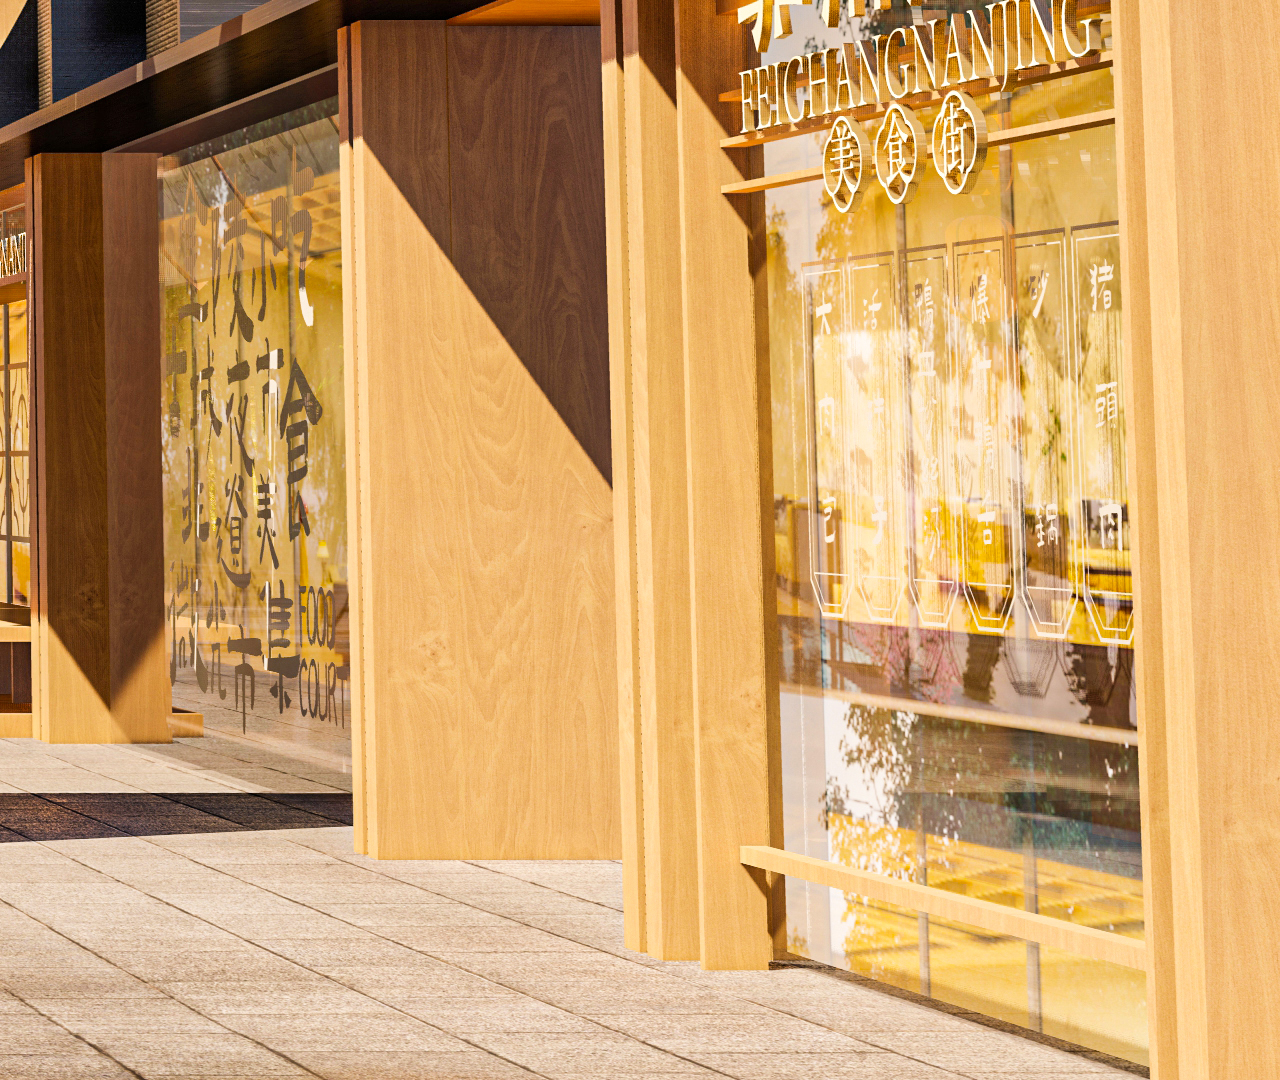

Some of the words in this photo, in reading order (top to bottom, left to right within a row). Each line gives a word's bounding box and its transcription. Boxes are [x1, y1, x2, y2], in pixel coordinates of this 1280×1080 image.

[827, 95, 976, 194] 美食街
[298, 585, 336, 651] FOOD
[298, 657, 351, 730] COURT
